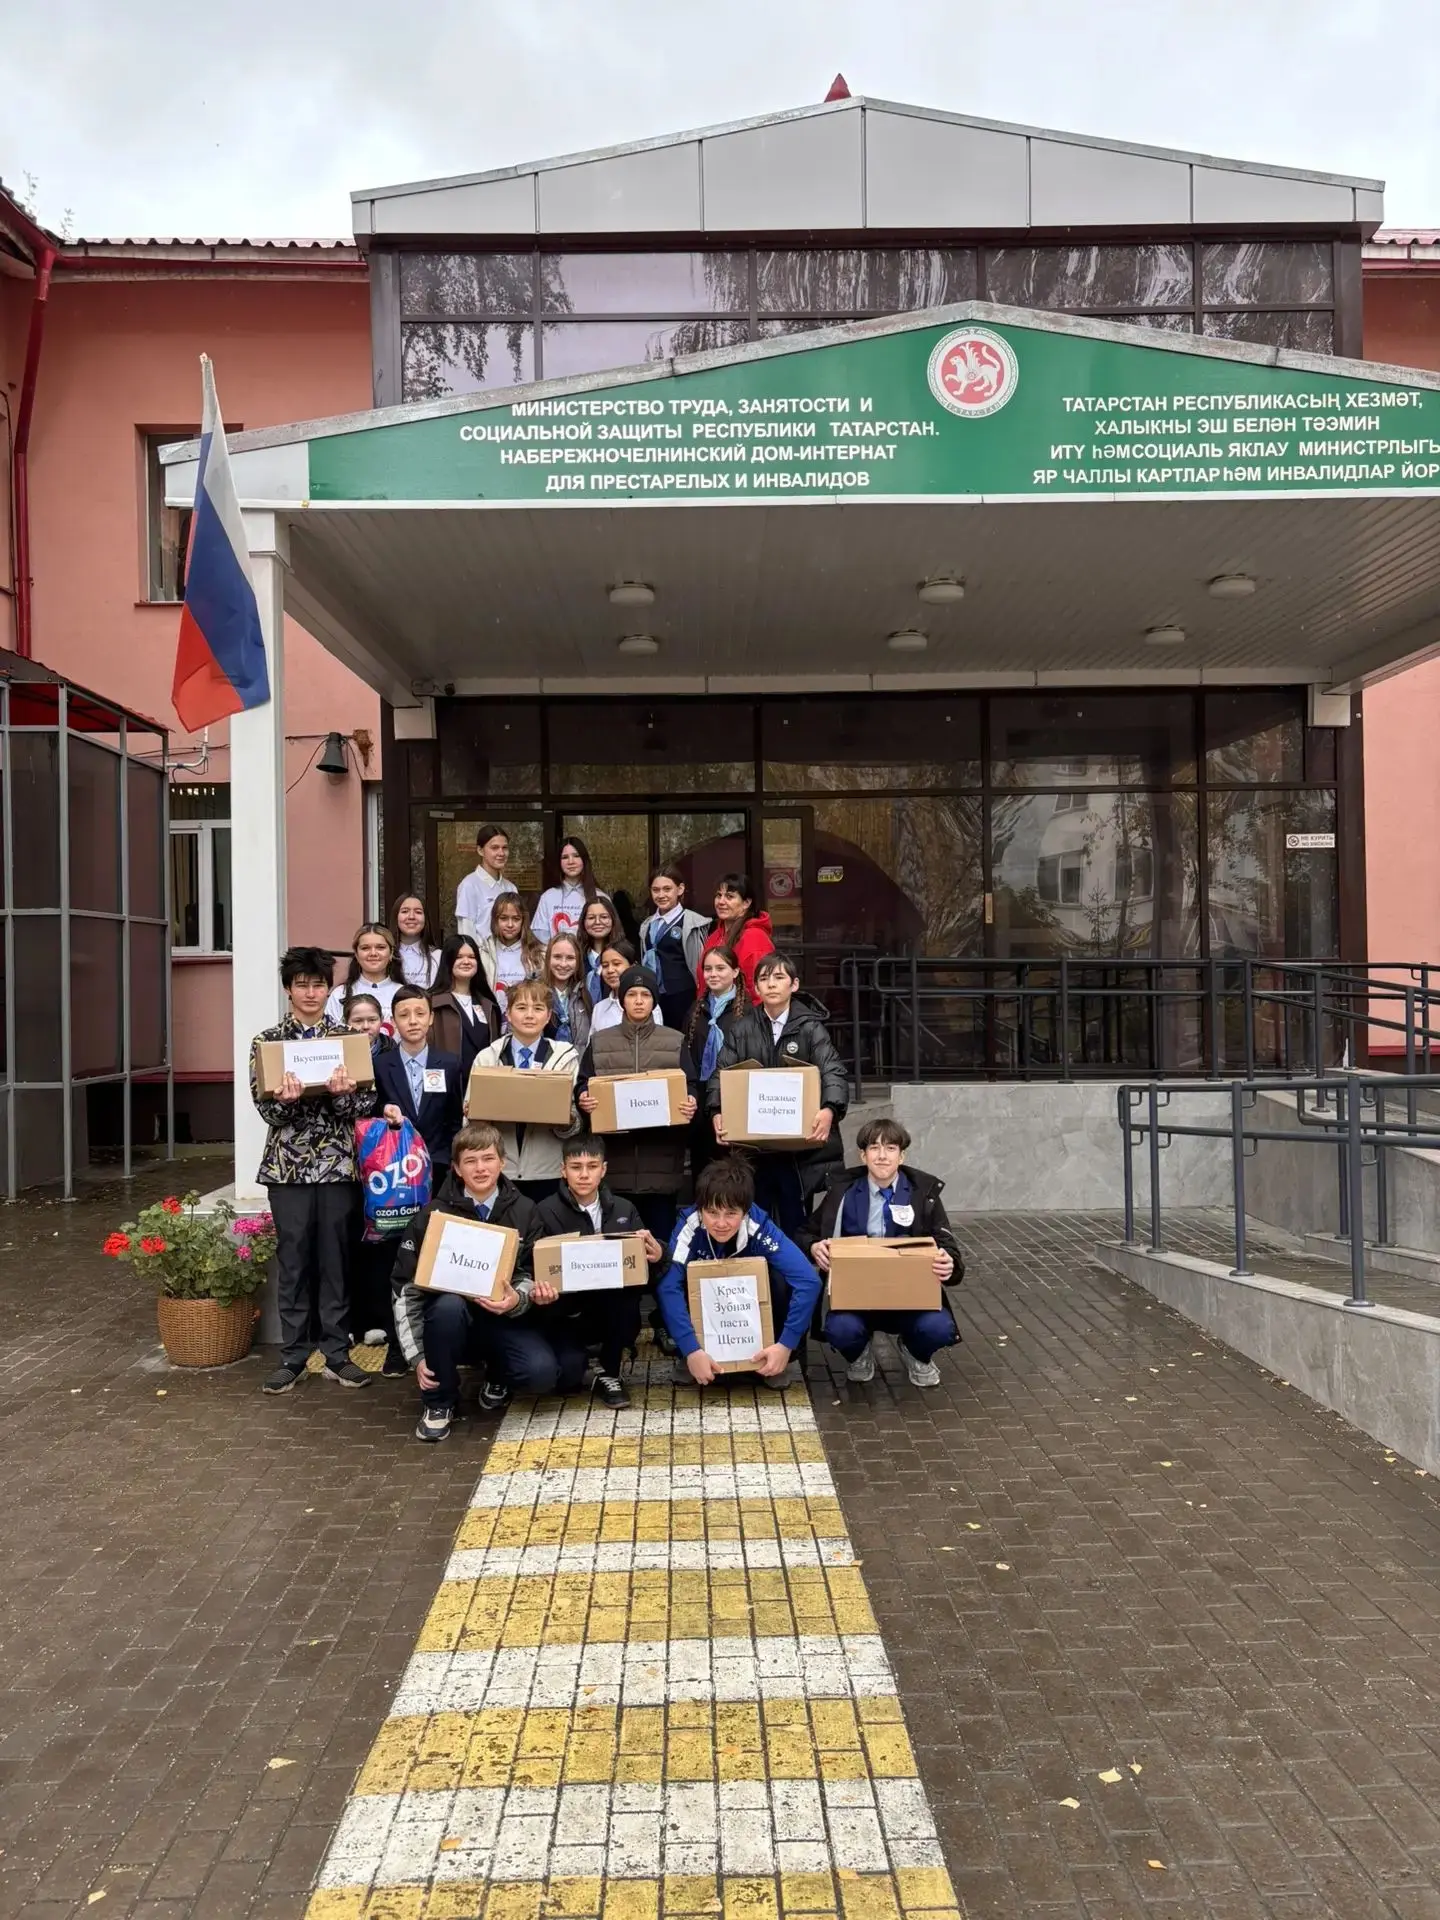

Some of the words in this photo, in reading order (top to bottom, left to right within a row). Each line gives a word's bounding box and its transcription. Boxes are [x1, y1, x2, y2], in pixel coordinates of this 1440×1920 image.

[1063, 397, 1166, 411] ТАТАРСТАН
[1174, 394, 1340, 410] РЕСПУБЛИКАСЫҢ
[1346, 392, 1422, 408] ХЕЗМӘТ,
[511, 400, 664, 416] МИНИСТЕРСТВО
[669, 400, 732, 417] ТРУДА,
[739, 398, 849, 413] ЗАНЯТОСТИ
[861, 398, 872, 411] И
[1096, 420, 1190, 434] ХАЛЫКНЫ
[1198, 419, 1227, 433] ЭШ
[1234, 418, 1295, 432] БЕЛӘН
[1302, 416, 1379, 431] ТӘЭМИН
[460, 422, 592, 443] СОЦИАЛЬНОЙ
[598, 424, 681, 441] ЗАЩИТЫ
[693, 423, 815, 438] РЕСПУБЛИКИ
[830, 421, 940, 436] ТАТАРСТАН.
[501, 444, 745, 464] НАБЕРЕЖНОЧЕЛНИНСКИЙ
[751, 445, 896, 463] ДОМ-ИНТЕРНАТ
[1228, 443, 1288, 457] ЯКЛАУ
[1034, 470, 1057, 483] ЯР
[1064, 469, 1130, 483] ЧАЛЛЫ
[1137, 468, 1220, 482] КАРТЛАР
[1268, 465, 1394, 481] ИНВАЛИДЛАР
[546, 475, 584, 492] ДЛЯ
[591, 474, 729, 489] ПРЕСТАРЕЛЫХ
[735, 474, 747, 488] И
[754, 472, 869, 489] ИНВАЛИДОВ
[293, 1053, 340, 1064] Вкусняшки
[629, 1098, 659, 1108] Носки
[758, 1093, 796, 1103] Влажные
[758, 1106, 796, 1116] салфетки
[376, 1209, 399, 1217] ozon
[449, 1251, 490, 1271] Мыло
[570, 1261, 618, 1271] Вкусняшки
[717, 1286, 745, 1297] Крем
[714, 1303, 751, 1314] Зубная
[720, 1319, 749, 1328] паста
[717, 1335, 754, 1346] Щетки
